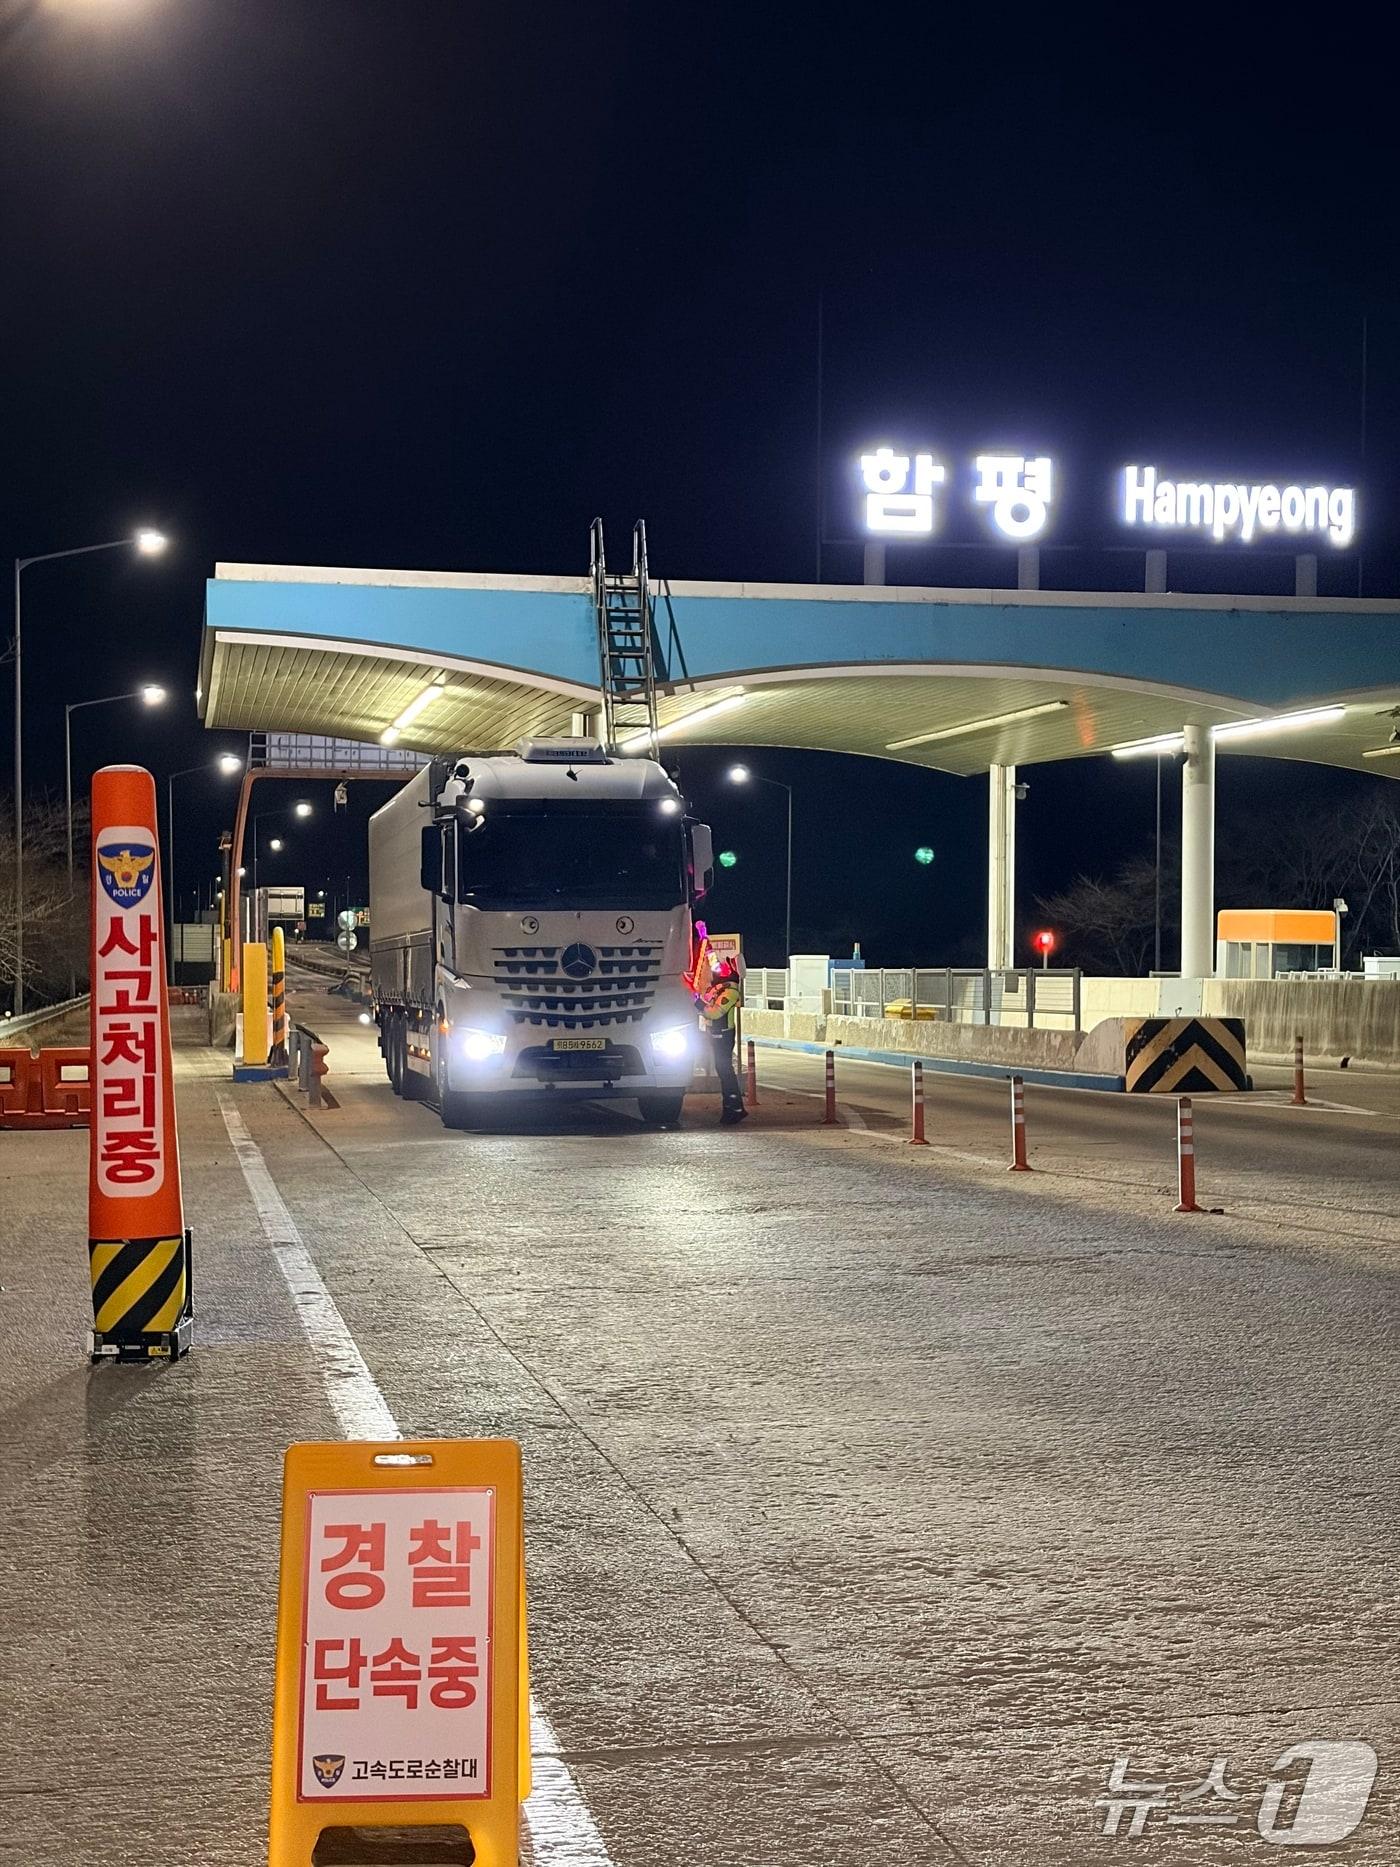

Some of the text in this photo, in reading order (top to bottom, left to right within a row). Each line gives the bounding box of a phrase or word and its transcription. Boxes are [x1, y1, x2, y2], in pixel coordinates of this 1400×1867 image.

[1123, 465, 1356, 545] Hampyeong
[112, 888, 142, 897] POLICE
[97, 914, 161, 1185] 사고처리중
[313, 1636, 480, 1711] 단속중
[351, 1757, 478, 1781] 고속도로순찰대
